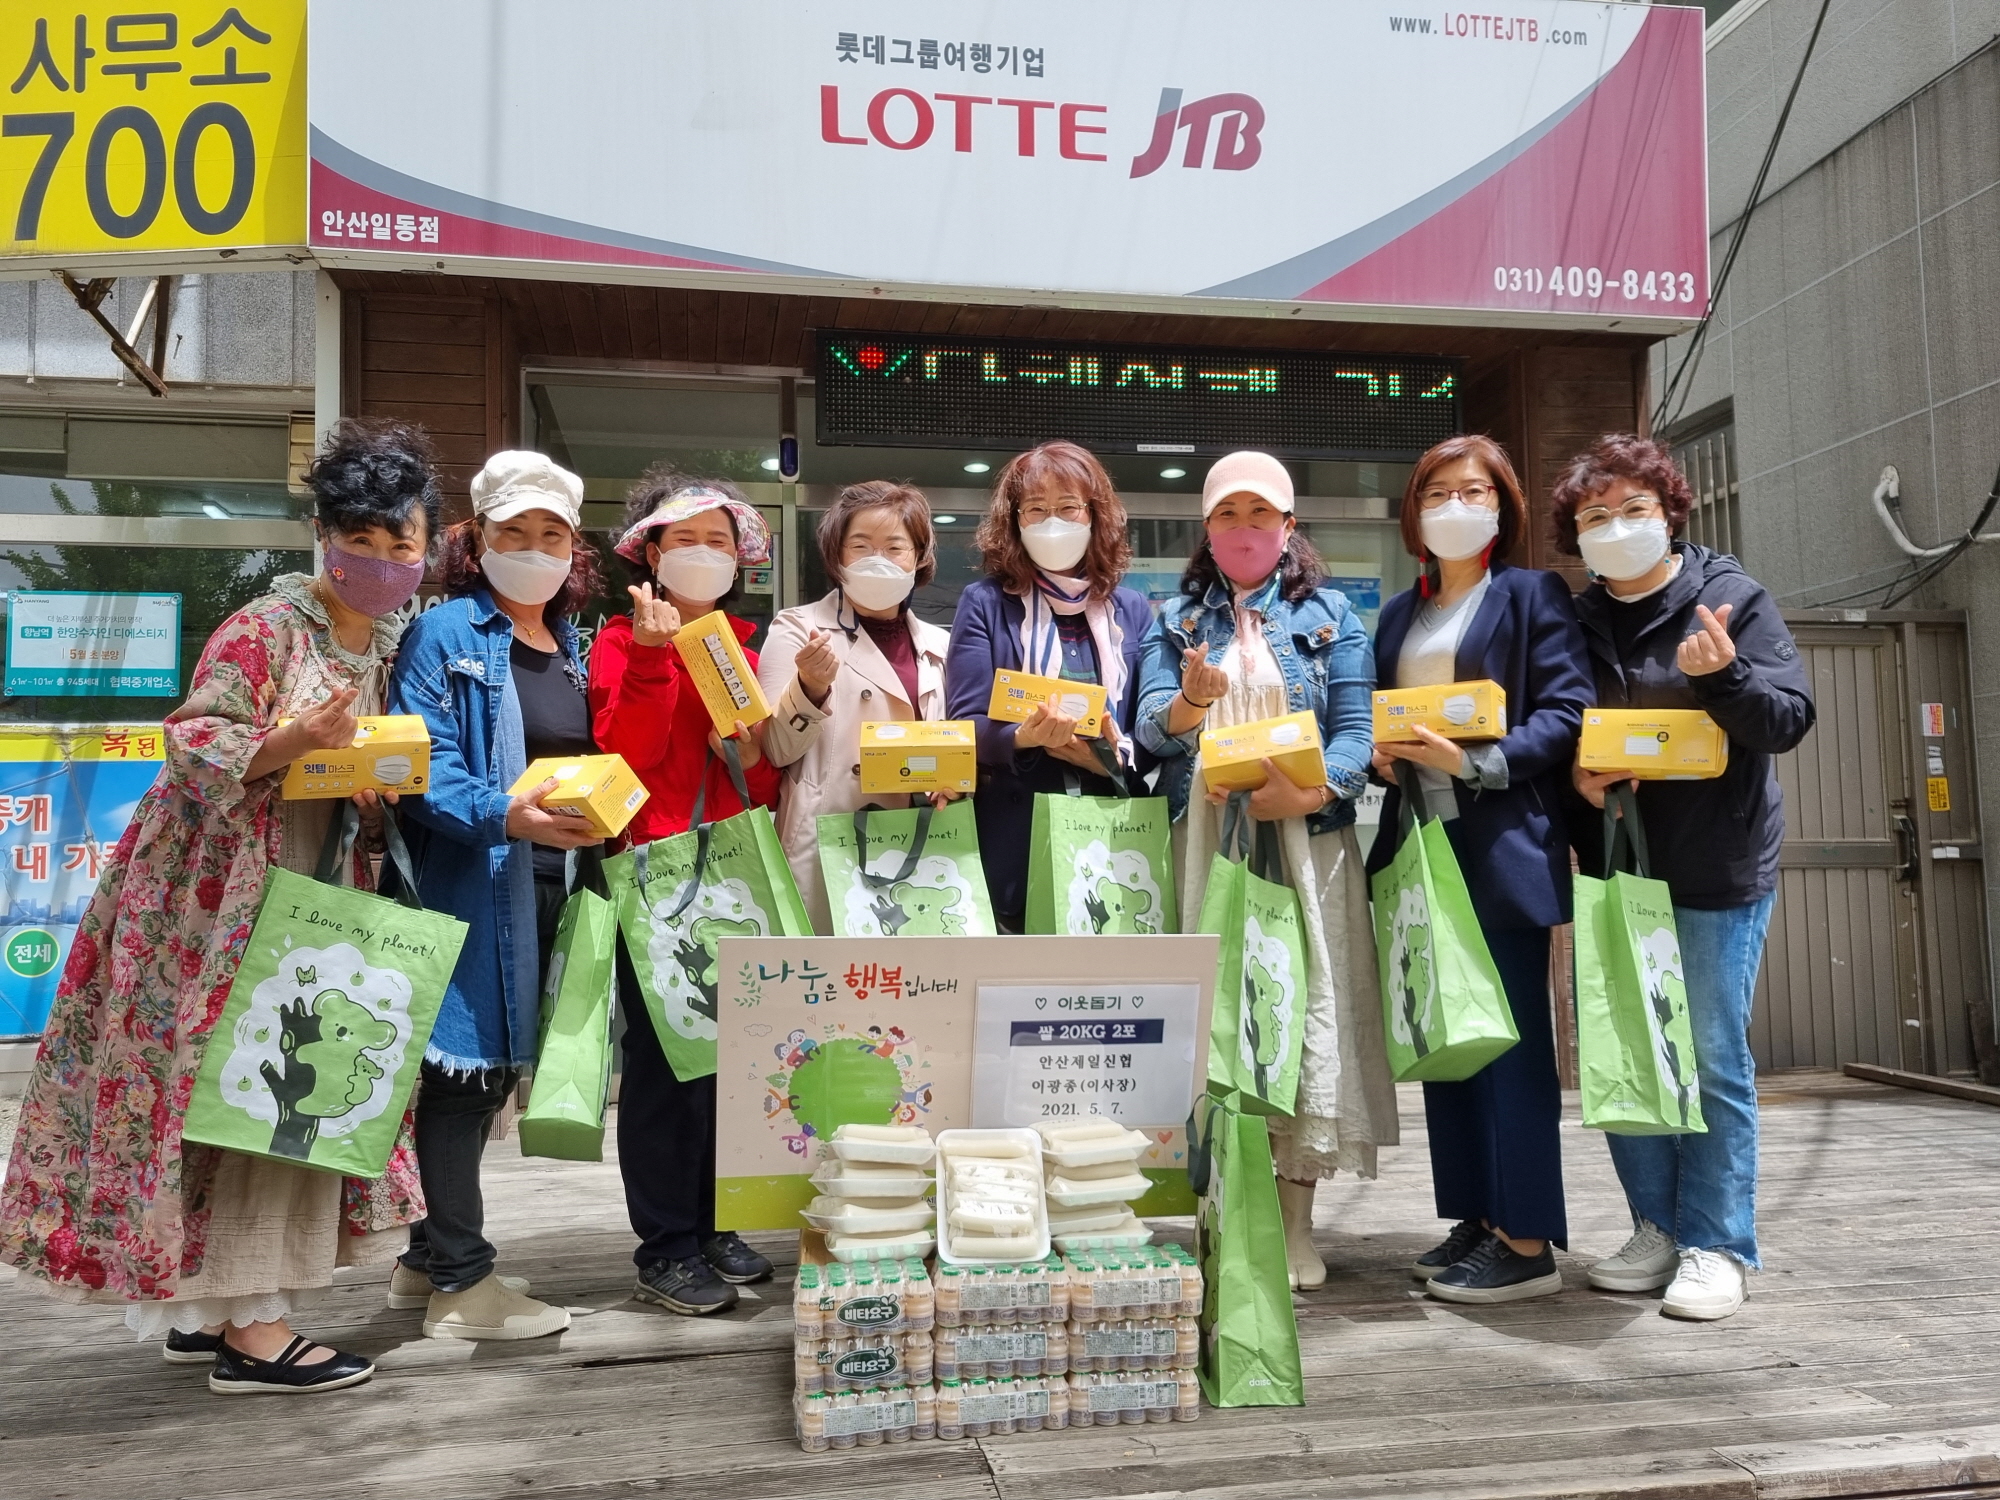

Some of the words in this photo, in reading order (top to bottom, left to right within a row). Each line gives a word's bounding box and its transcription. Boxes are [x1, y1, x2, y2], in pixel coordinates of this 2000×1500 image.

[1444, 12, 1539, 42] LOTTEJTB
[11, 7, 272, 94] 사무소
[834, 31, 1046, 78] 롯데그룹여행기업
[820, 84, 1108, 163] LOTTE
[1129, 87, 1266, 179] JTB
[1, 101, 256, 241] 700
[320, 209, 441, 244] 안산일동점
[57, 627, 111, 639] 한양수자인
[114, 627, 168, 640] 디에스티지
[69, 649, 87, 660] 5월
[89, 650, 99, 659] 초
[101, 650, 120, 660] 분양
[67, 677, 99, 686] 945세대
[109, 676, 175, 688] 협력중개업소
[303, 763, 327, 775] 잇템
[328, 764, 356, 774] 마스크
[837, 836, 848, 848] I
[890, 833, 909, 846] my
[928, 828, 959, 840] anet!
[1112, 820, 1152, 839] planet!
[15, 845, 46, 880] 내
[627, 876, 640, 889] I
[645, 868, 676, 884] love
[705, 842, 744, 871] planet!
[1636, 902, 1658, 919] love
[288, 905, 301, 920] I
[305, 910, 343, 932] love
[351, 926, 376, 944] my
[380, 933, 437, 960] planet!
[13, 944, 52, 965] 전세
[757, 958, 838, 1005] 나눔은
[842, 962, 959, 1001] 행복입니다!
[1057, 995, 1122, 1011] 이웃돕기
[1038, 1024, 1055, 1042] 쌀
[1059, 1024, 1107, 1040] 20KG
[1111, 1023, 1137, 1039] 2포
[1039, 1053, 1132, 1070] 안산제일신협
[1031, 1077, 1137, 1095] 이광종(이사장)
[1041, 1102, 1081, 1116] 2021.
[1089, 1102, 1102, 1116] 5.
[1110, 1102, 1124, 1115] 7.
[844, 1306, 894, 1321] 비타요구
[841, 1359, 891, 1374] 비타요구
